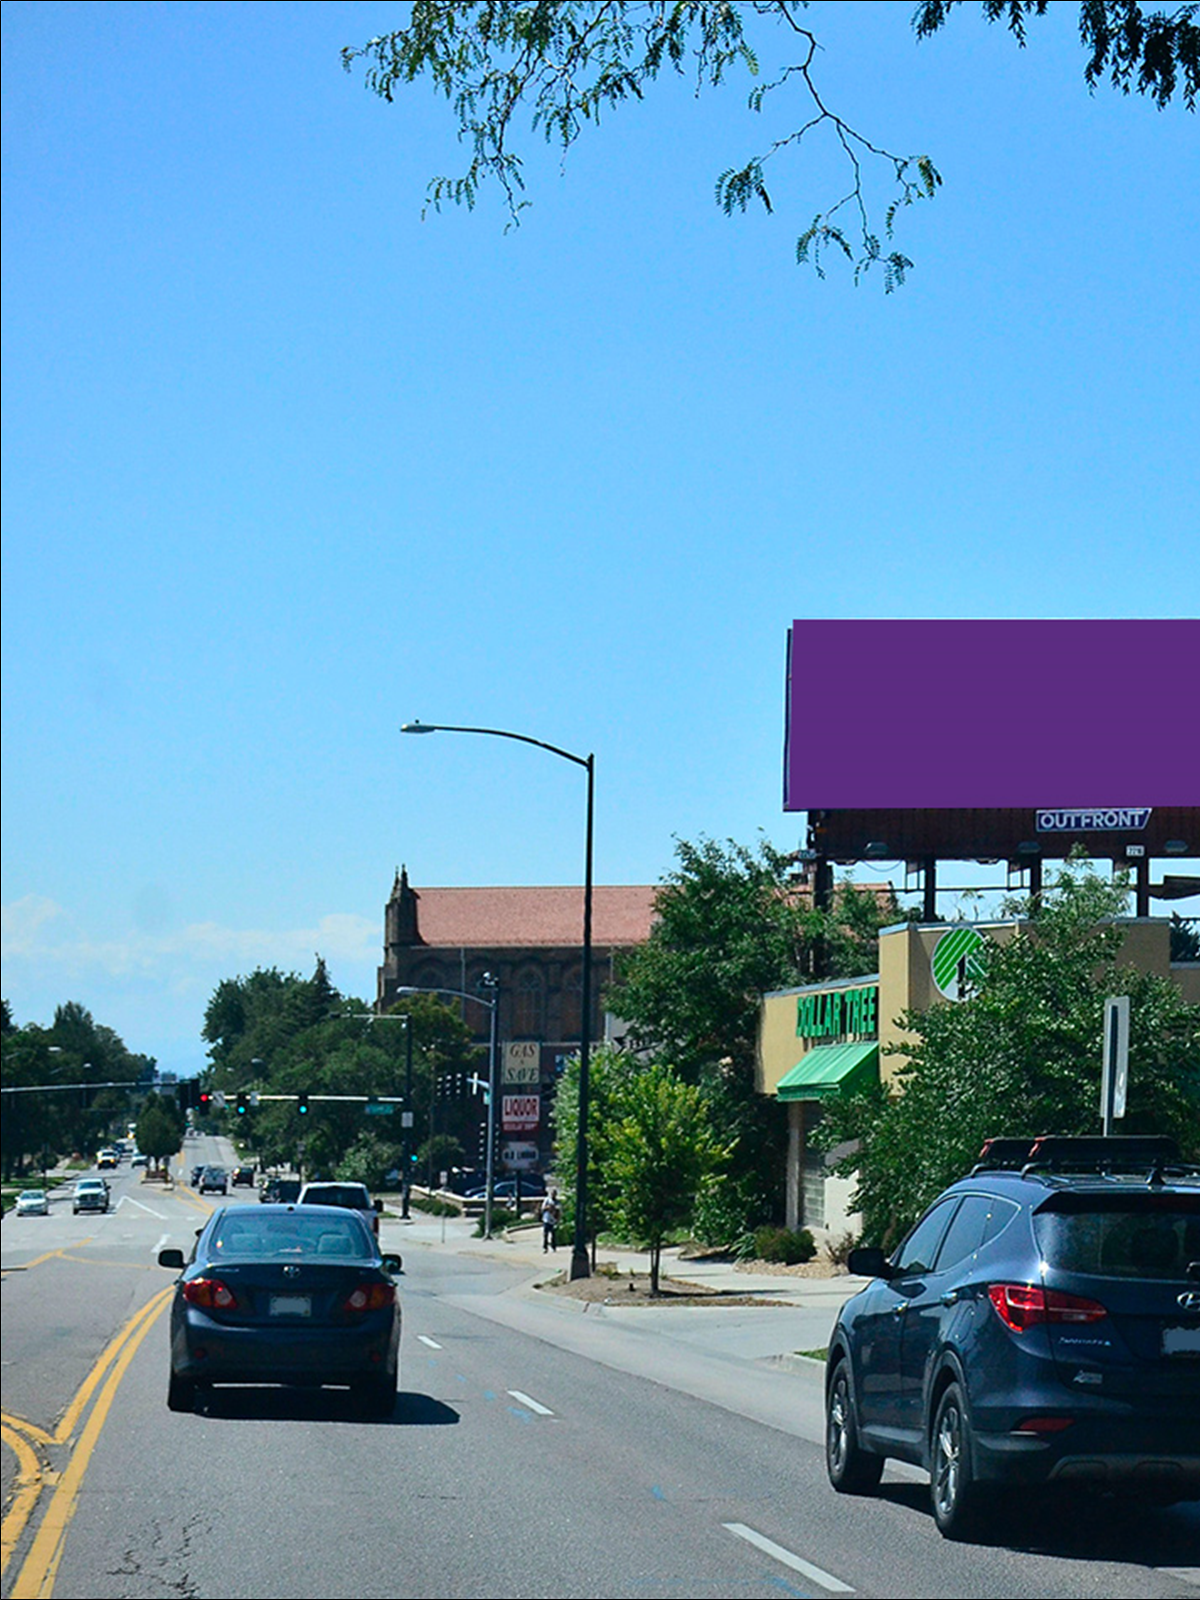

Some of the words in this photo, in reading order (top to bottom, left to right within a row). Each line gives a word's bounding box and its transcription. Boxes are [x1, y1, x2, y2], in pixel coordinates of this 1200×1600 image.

[1040, 810, 1145, 828] OUTFRONT
[796, 991, 841, 1038] DOLLAR
[844, 986, 877, 1035] TREE
[509, 1043, 536, 1058] GAS
[506, 1067, 539, 1082] SAVE
[504, 1098, 538, 1117] LIQUOR
